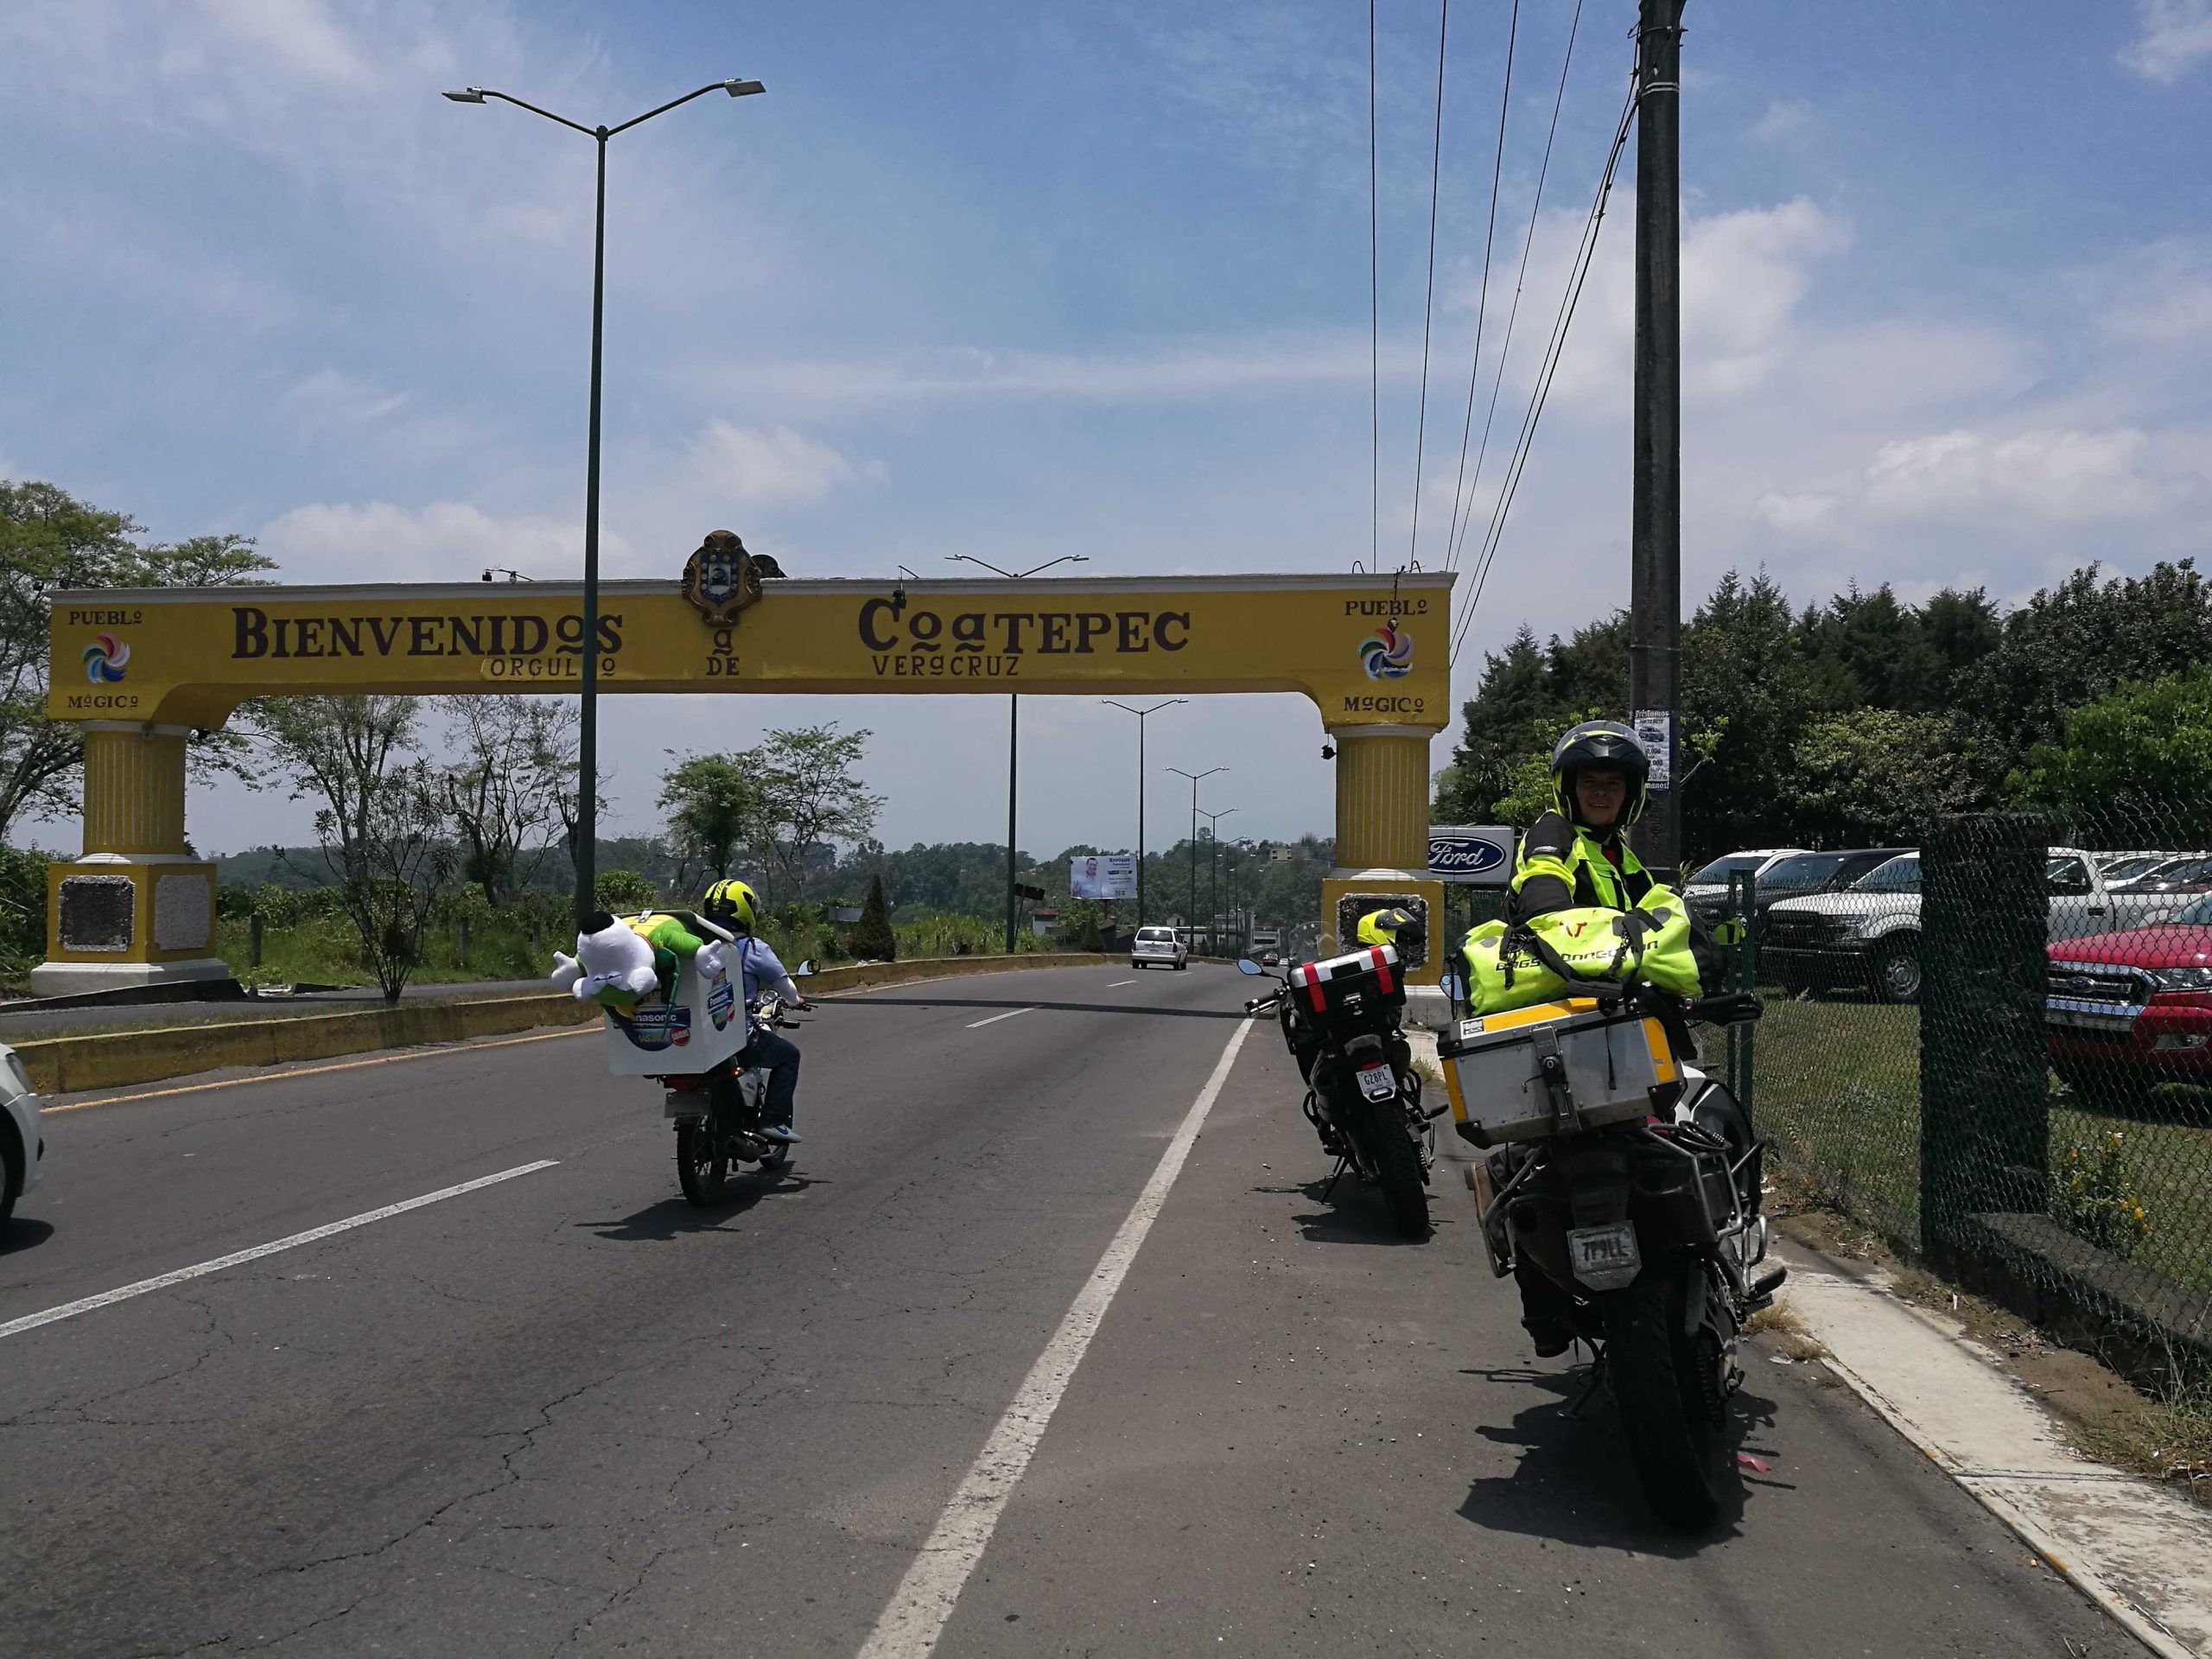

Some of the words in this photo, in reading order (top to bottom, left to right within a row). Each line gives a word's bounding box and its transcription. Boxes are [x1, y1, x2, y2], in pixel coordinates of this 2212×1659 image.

[69, 610, 143, 625] PUEBLO
[1344, 600, 1428, 615] PUEBLO
[232, 607, 623, 658] BIENVENIDOS
[858, 598, 1190, 654] COATEPEC
[490, 658, 615, 677] ORGULO
[706, 657, 740, 676] DE
[872, 655, 1020, 677] VERACRUZ
[1428, 841, 1484, 865] Ford
